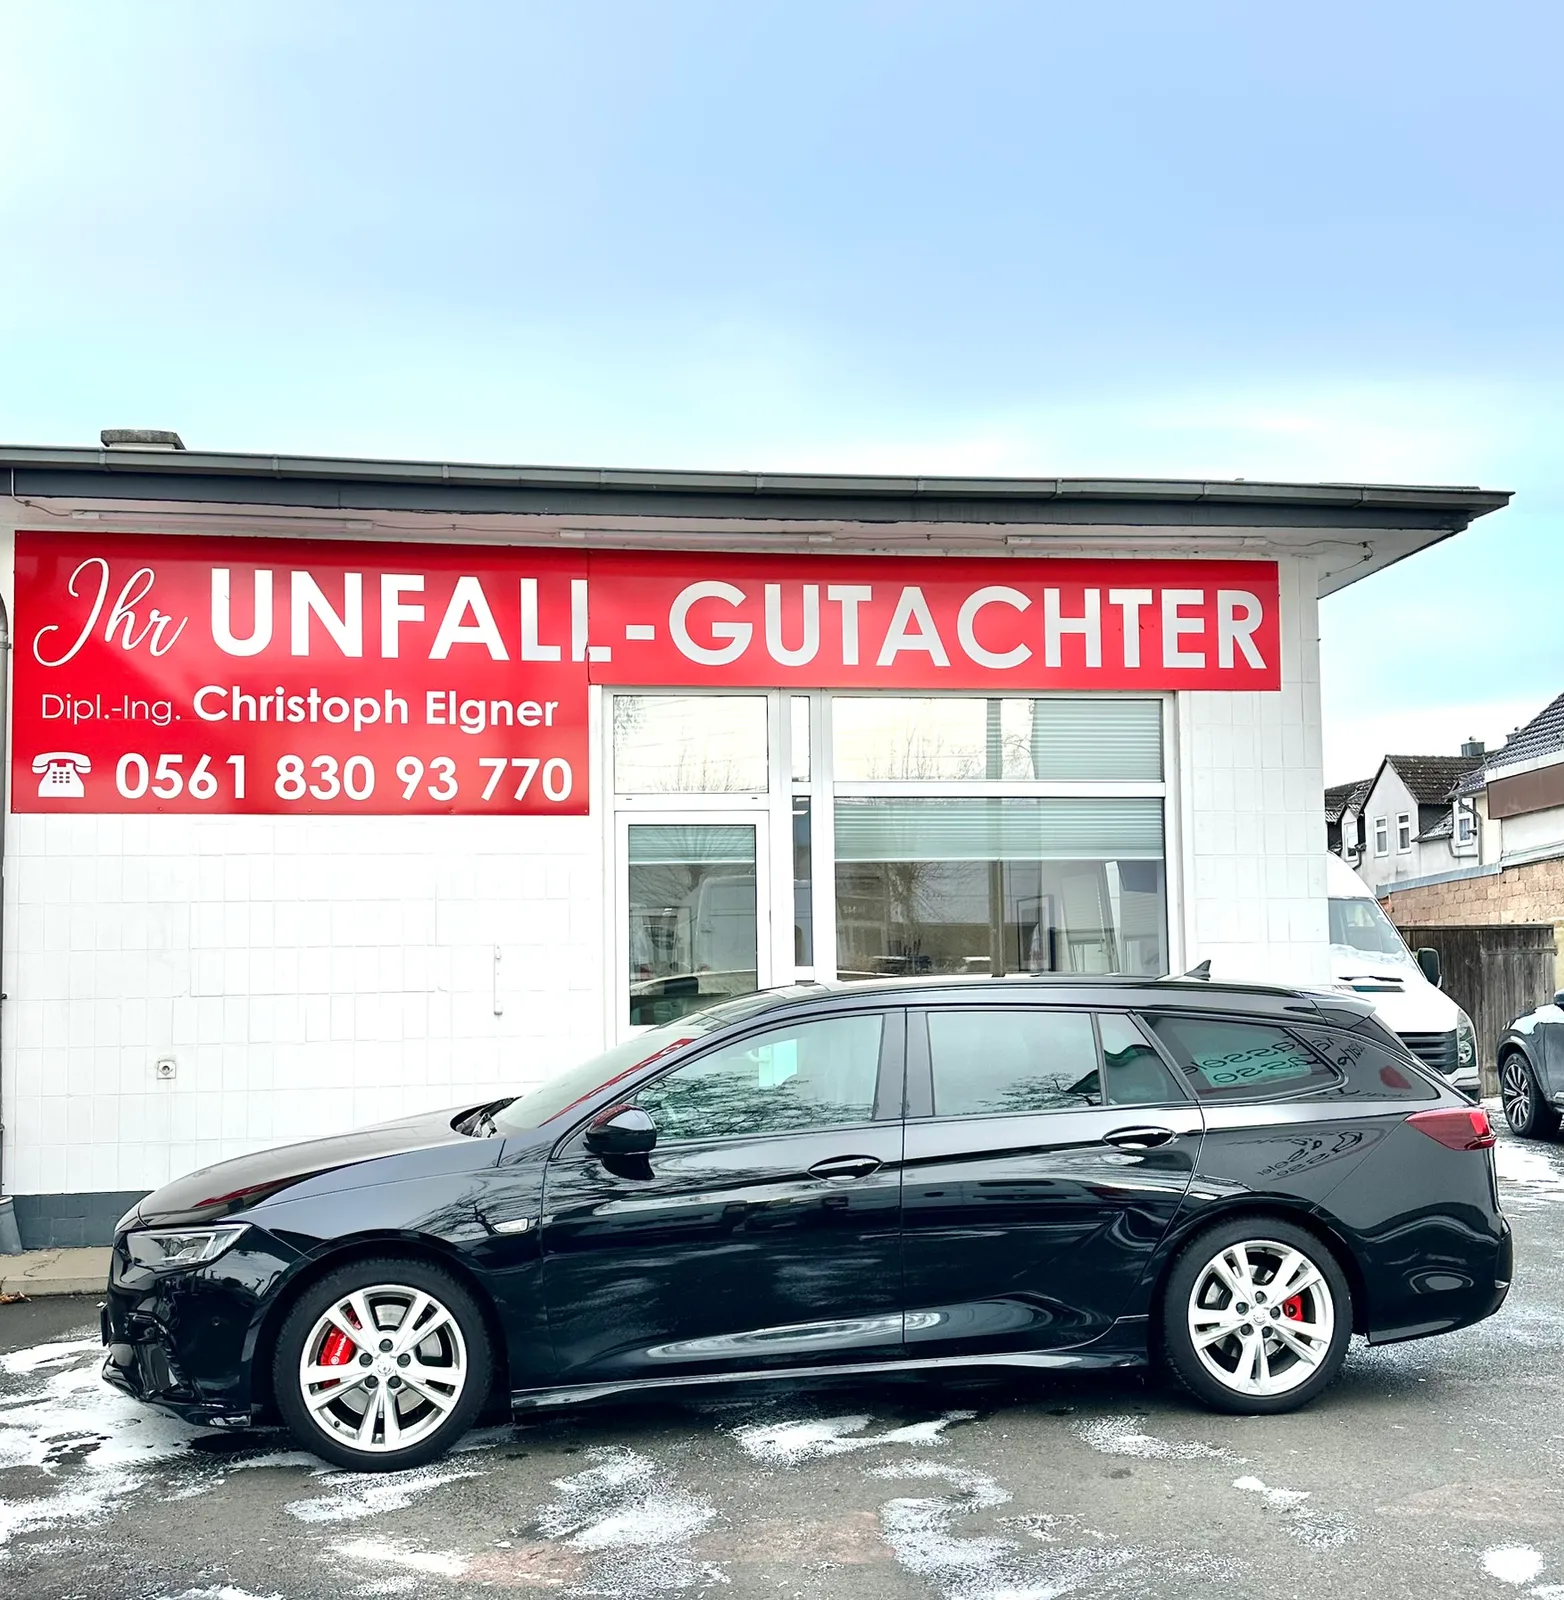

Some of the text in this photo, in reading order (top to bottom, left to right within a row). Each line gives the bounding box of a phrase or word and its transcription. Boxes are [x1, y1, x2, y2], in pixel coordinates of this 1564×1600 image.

[34, 557, 188, 667] Ihr
[42, 685, 559, 735] Dipl.-Ing. Christoph Elgner
[116, 753, 574, 802] 0561 830 93 770
